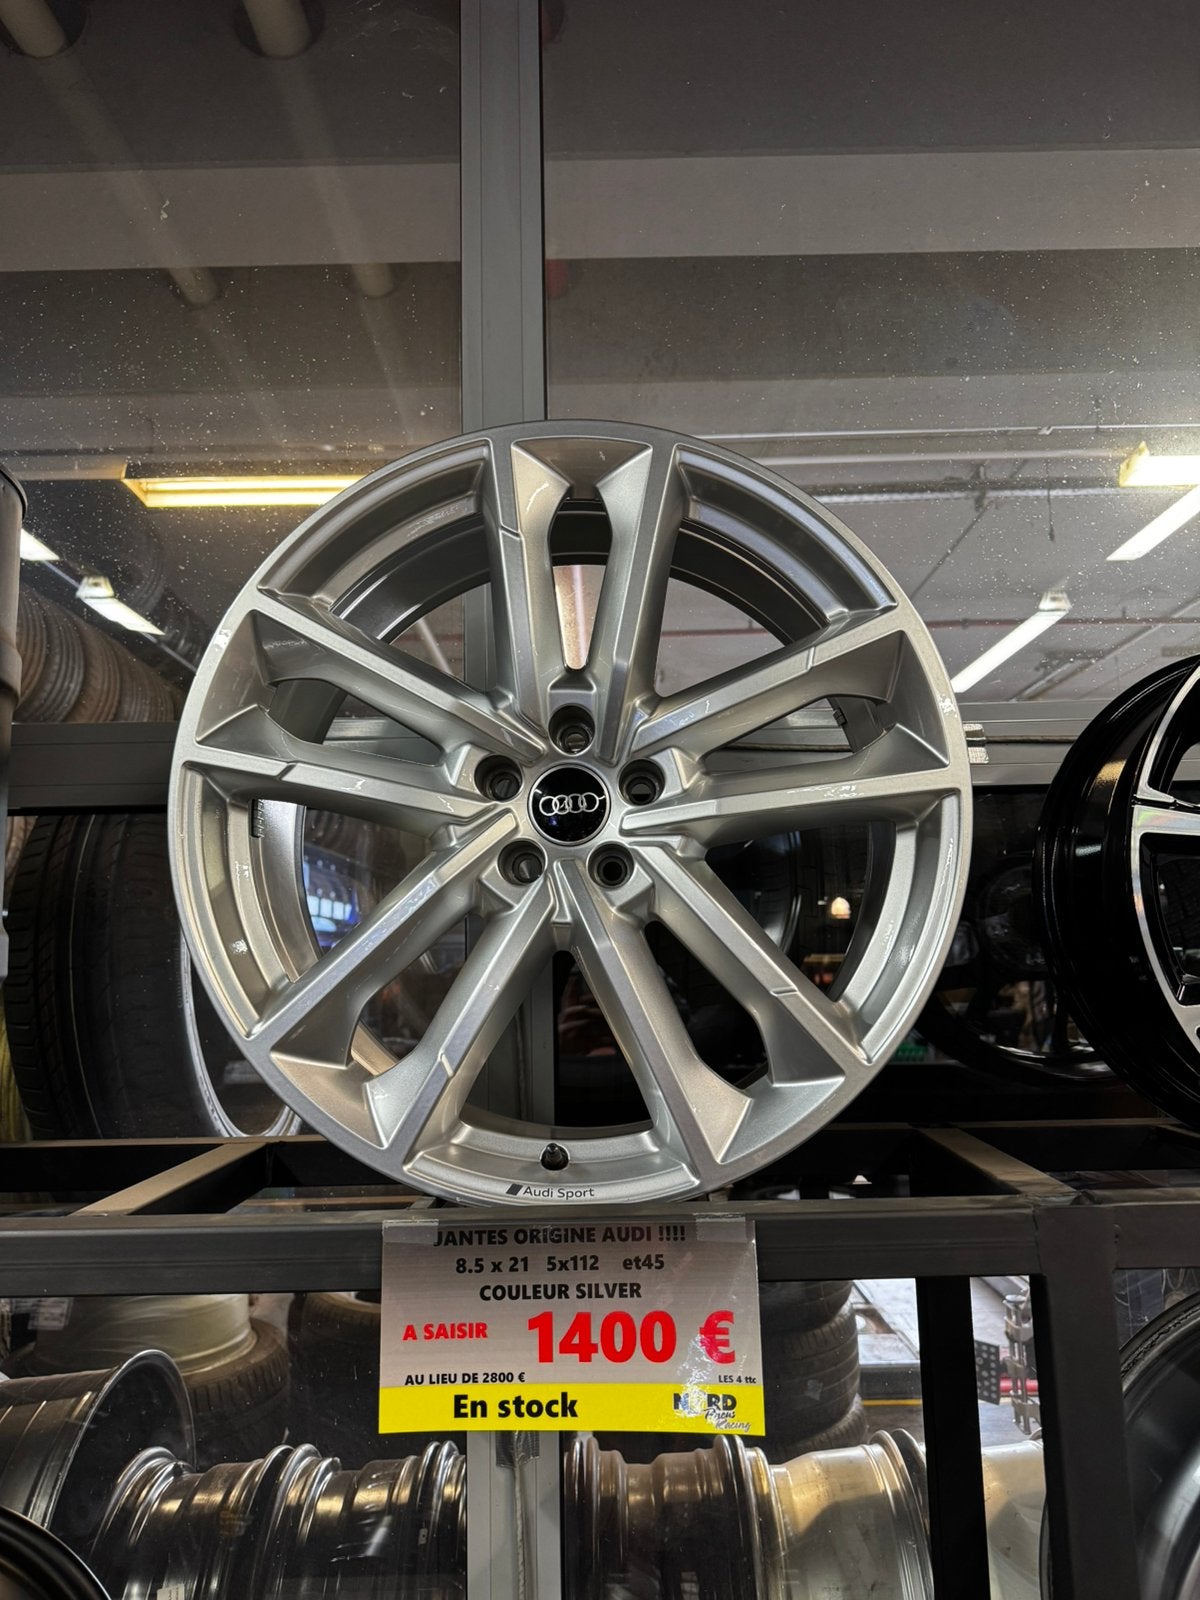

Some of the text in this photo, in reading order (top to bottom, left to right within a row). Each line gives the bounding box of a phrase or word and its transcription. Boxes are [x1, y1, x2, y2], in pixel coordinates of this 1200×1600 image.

[523, 1186, 595, 1200] Audi Sport
[433, 1225, 687, 1247] JANTES ORIGINE AUDI !!!!
[455, 1254, 665, 1274] 8.5 x 21 5x112 et45
[479, 1282, 642, 1301] COULEUR SILVER
[402, 1322, 488, 1341] A SAISIR
[527, 1309, 736, 1364] 1400 €
[404, 1371, 526, 1386] AU LIEU DE 2800 €
[718, 1375, 734, 1383] LES
[736, 1375, 743, 1384] 4
[453, 1392, 579, 1419] En stock
[673, 1392, 738, 1411] NRD
